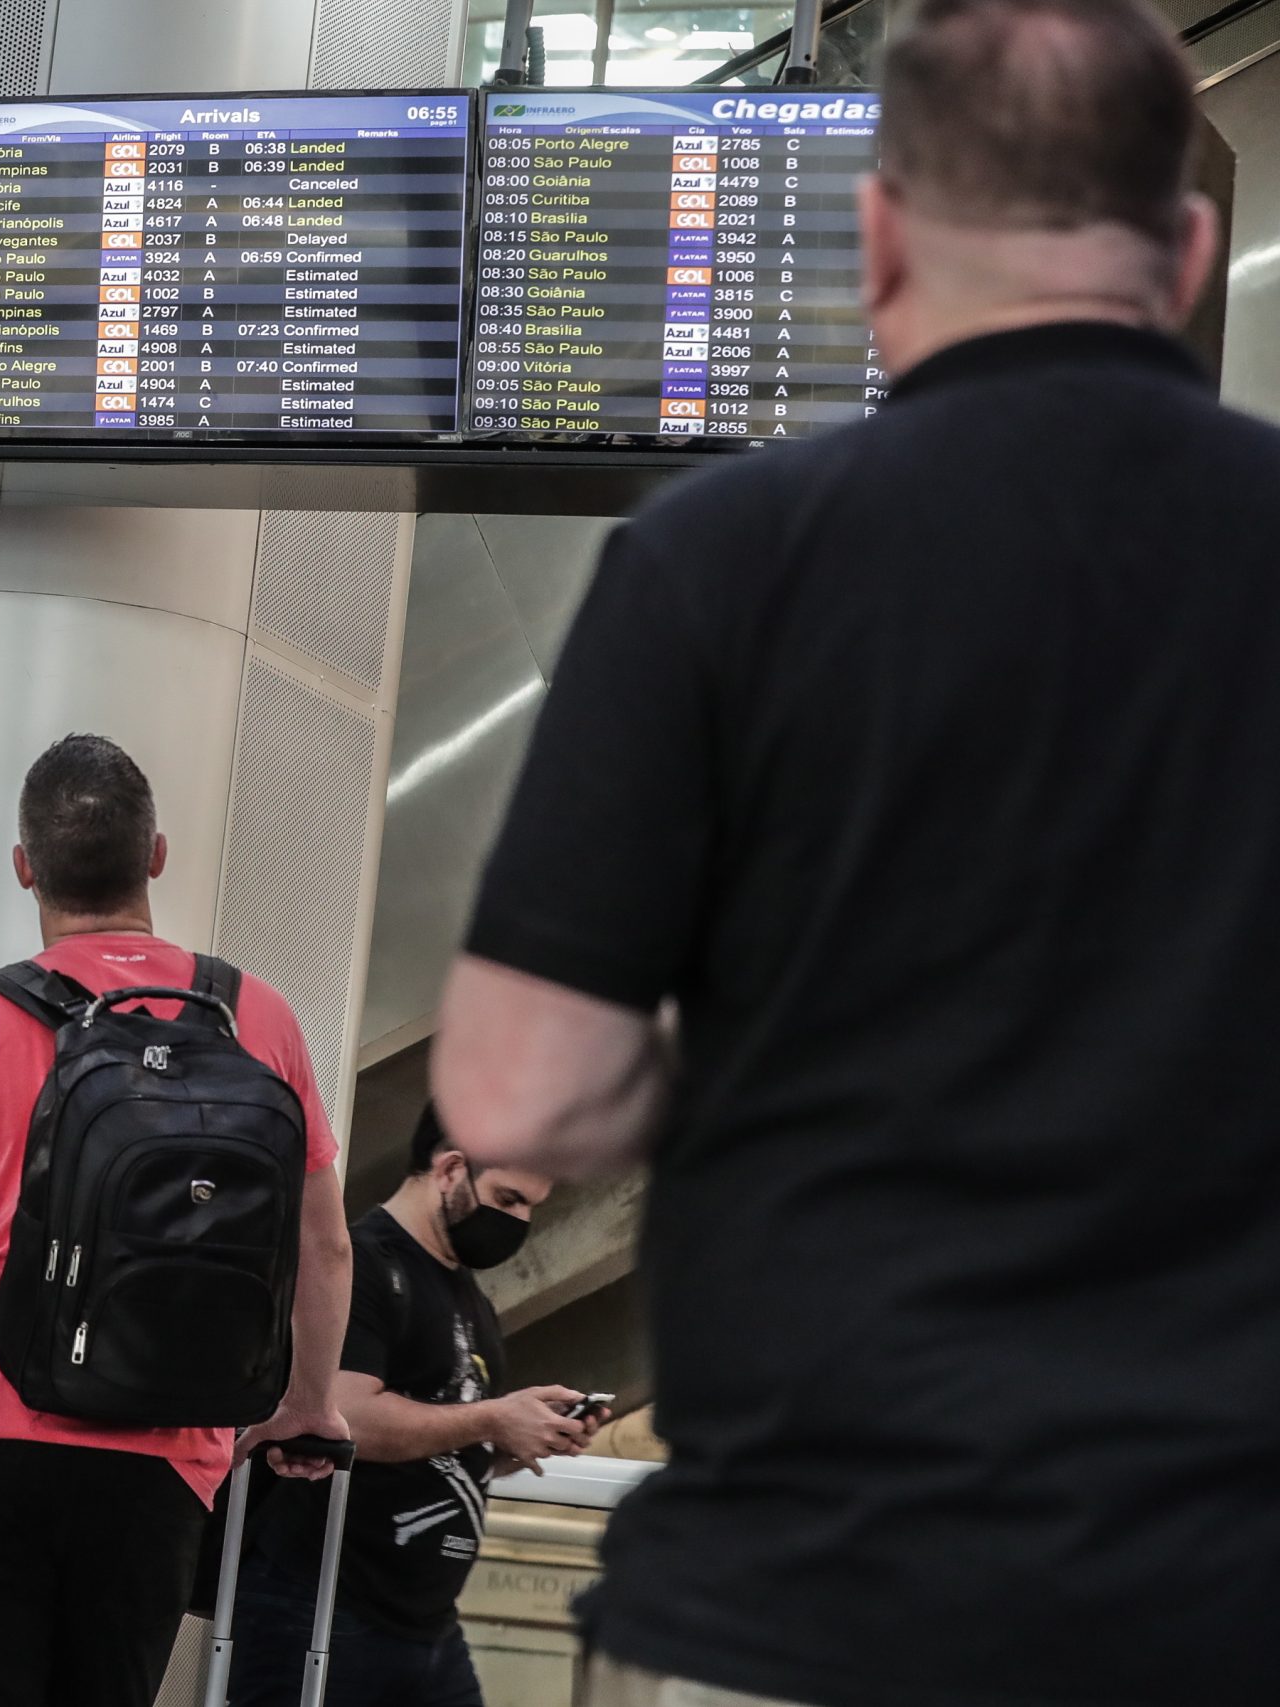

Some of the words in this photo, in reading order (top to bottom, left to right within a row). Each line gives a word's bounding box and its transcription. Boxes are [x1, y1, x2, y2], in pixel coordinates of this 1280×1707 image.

[180, 109, 260, 124] Arrivals
[407, 107, 457, 121] 06:55
[712, 99, 882, 122] Chegadas
[155, 132, 181, 141] Flight
[202, 132, 229, 140] Room
[112, 145, 140, 157] GOL
[149, 144, 185, 155] 2079
[209, 144, 219, 155] B
[245, 143, 286, 154] 06:38
[291, 142, 345, 154] Landed
[489, 139, 531, 150] 08:05
[534, 139, 575, 150] Porto
[579, 139, 629, 152] Alegre
[675, 140, 702, 150] Azul
[721, 139, 760, 150] 2785
[787, 140, 800, 150] C
[105, 183, 130, 192] Azul
[147, 180, 183, 191] 4116
[289, 178, 358, 190] Canceled
[487, 176, 529, 186] 08:00
[533, 175, 591, 186] Goiânia
[673, 178, 700, 187] Azul
[720, 177, 759, 188] 4479
[785, 178, 798, 188] C
[485, 213, 527, 224] 08:10
[531, 212, 587, 224] Brasília
[677, 214, 708, 226] GOL
[718, 215, 755, 225] 2021
[784, 215, 795, 226] B
[108, 235, 137, 247] GOL
[146, 235, 181, 246] 2037
[206, 234, 216, 245] B
[287, 233, 348, 247] Delayed
[7, 254, 45, 264] Paulo
[145, 253, 180, 263] 3924
[204, 252, 216, 263] A
[241, 252, 282, 263] 06:59
[286, 252, 362, 263] Confirmed
[101, 309, 125, 318] Azul
[142, 307, 178, 318] 2797
[202, 307, 214, 318] A
[284, 307, 357, 318] Estimated
[478, 361, 520, 373] 09:00
[524, 361, 572, 373] Vitória
[711, 366, 750, 376] 3997
[776, 367, 789, 378] A
